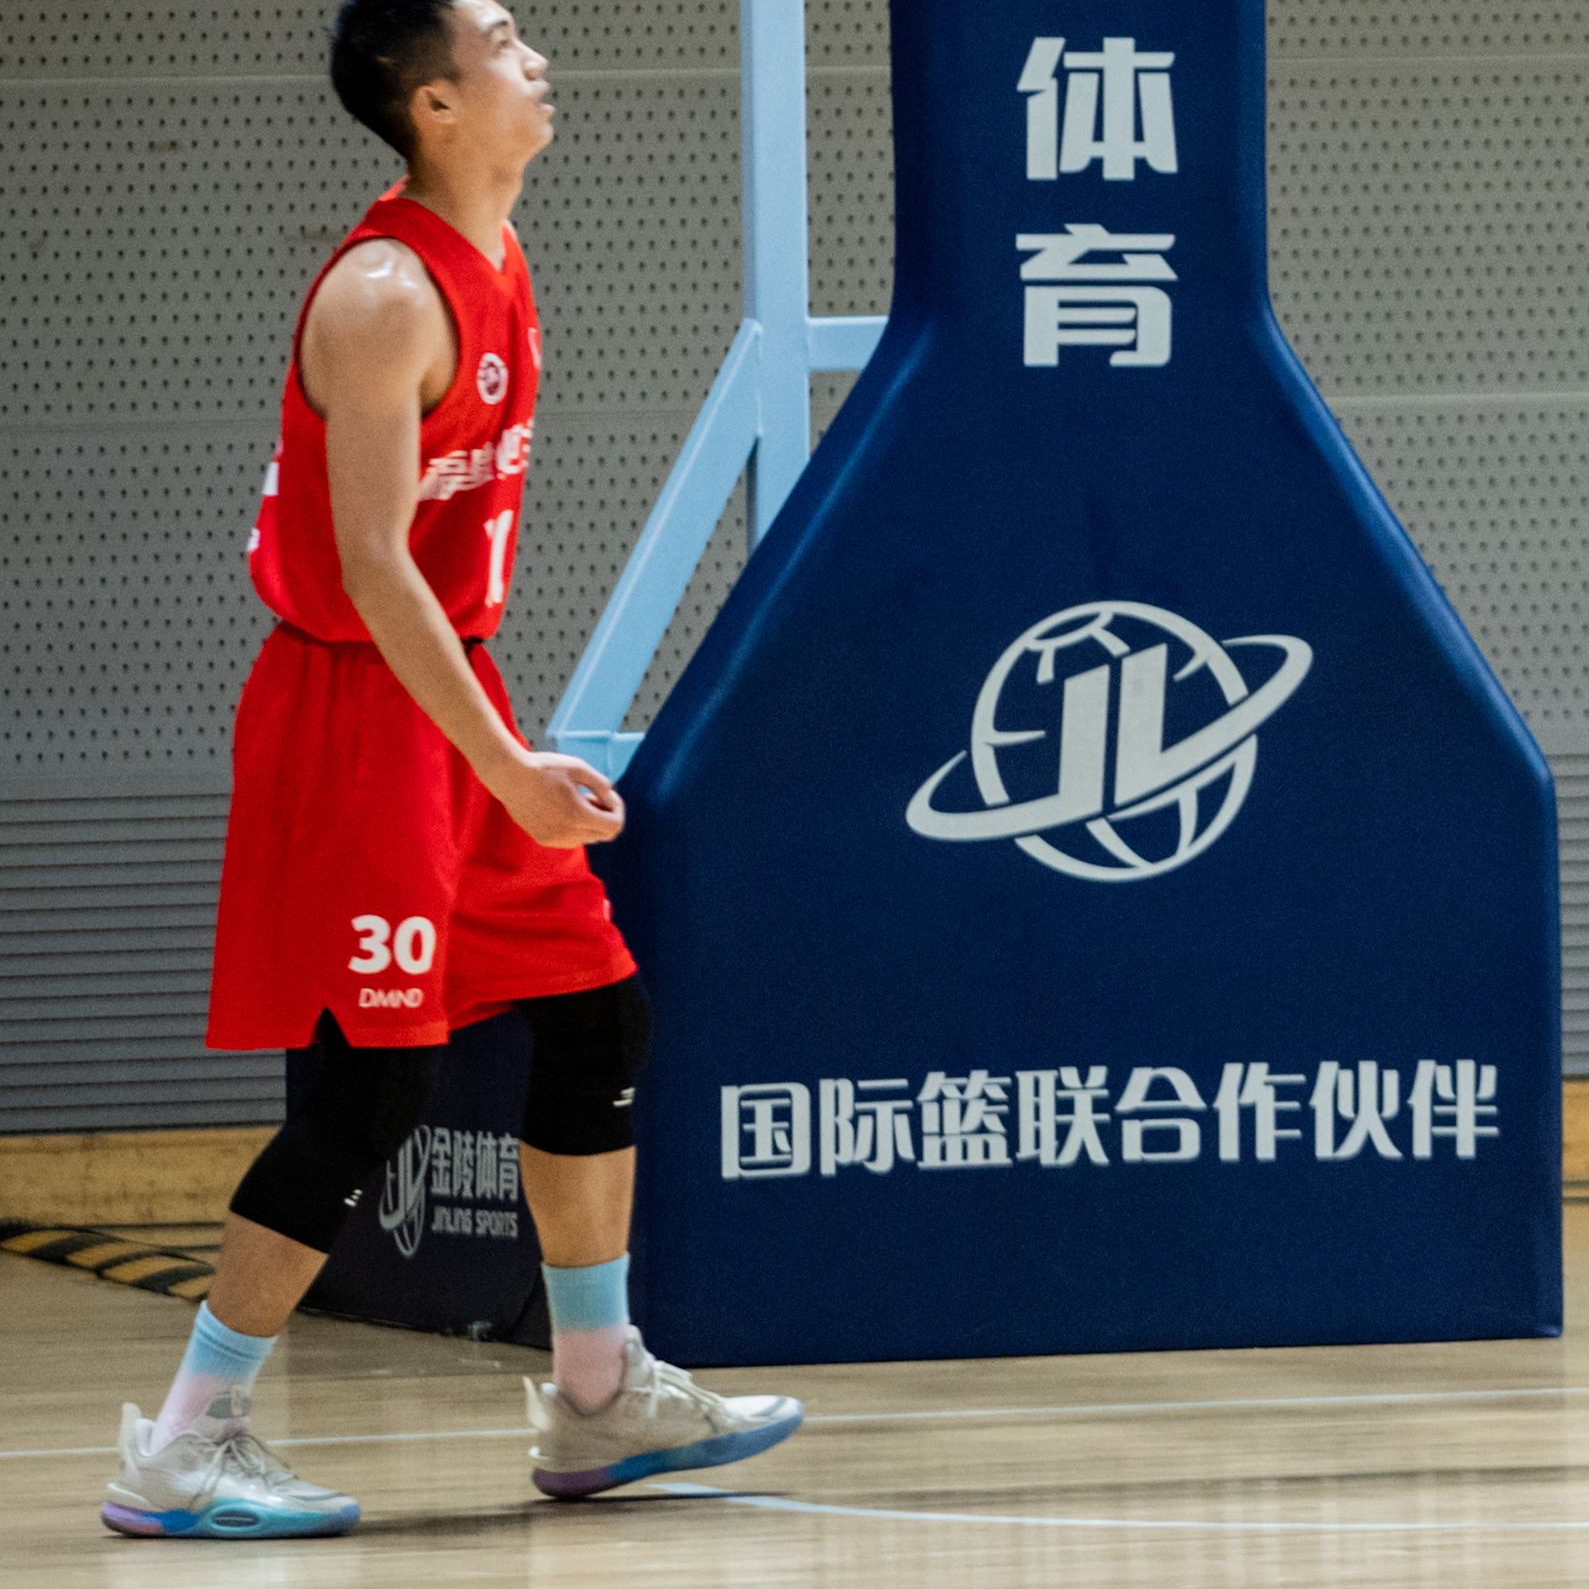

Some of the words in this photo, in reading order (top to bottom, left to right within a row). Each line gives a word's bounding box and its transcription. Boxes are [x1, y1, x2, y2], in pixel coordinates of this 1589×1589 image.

[348, 914, 436, 974] 30
[359, 987, 424, 1008] DMND
[720, 1059, 1499, 1180] 国际篮联合作伙伴
[431, 1127, 519, 1201] 金陵体育
